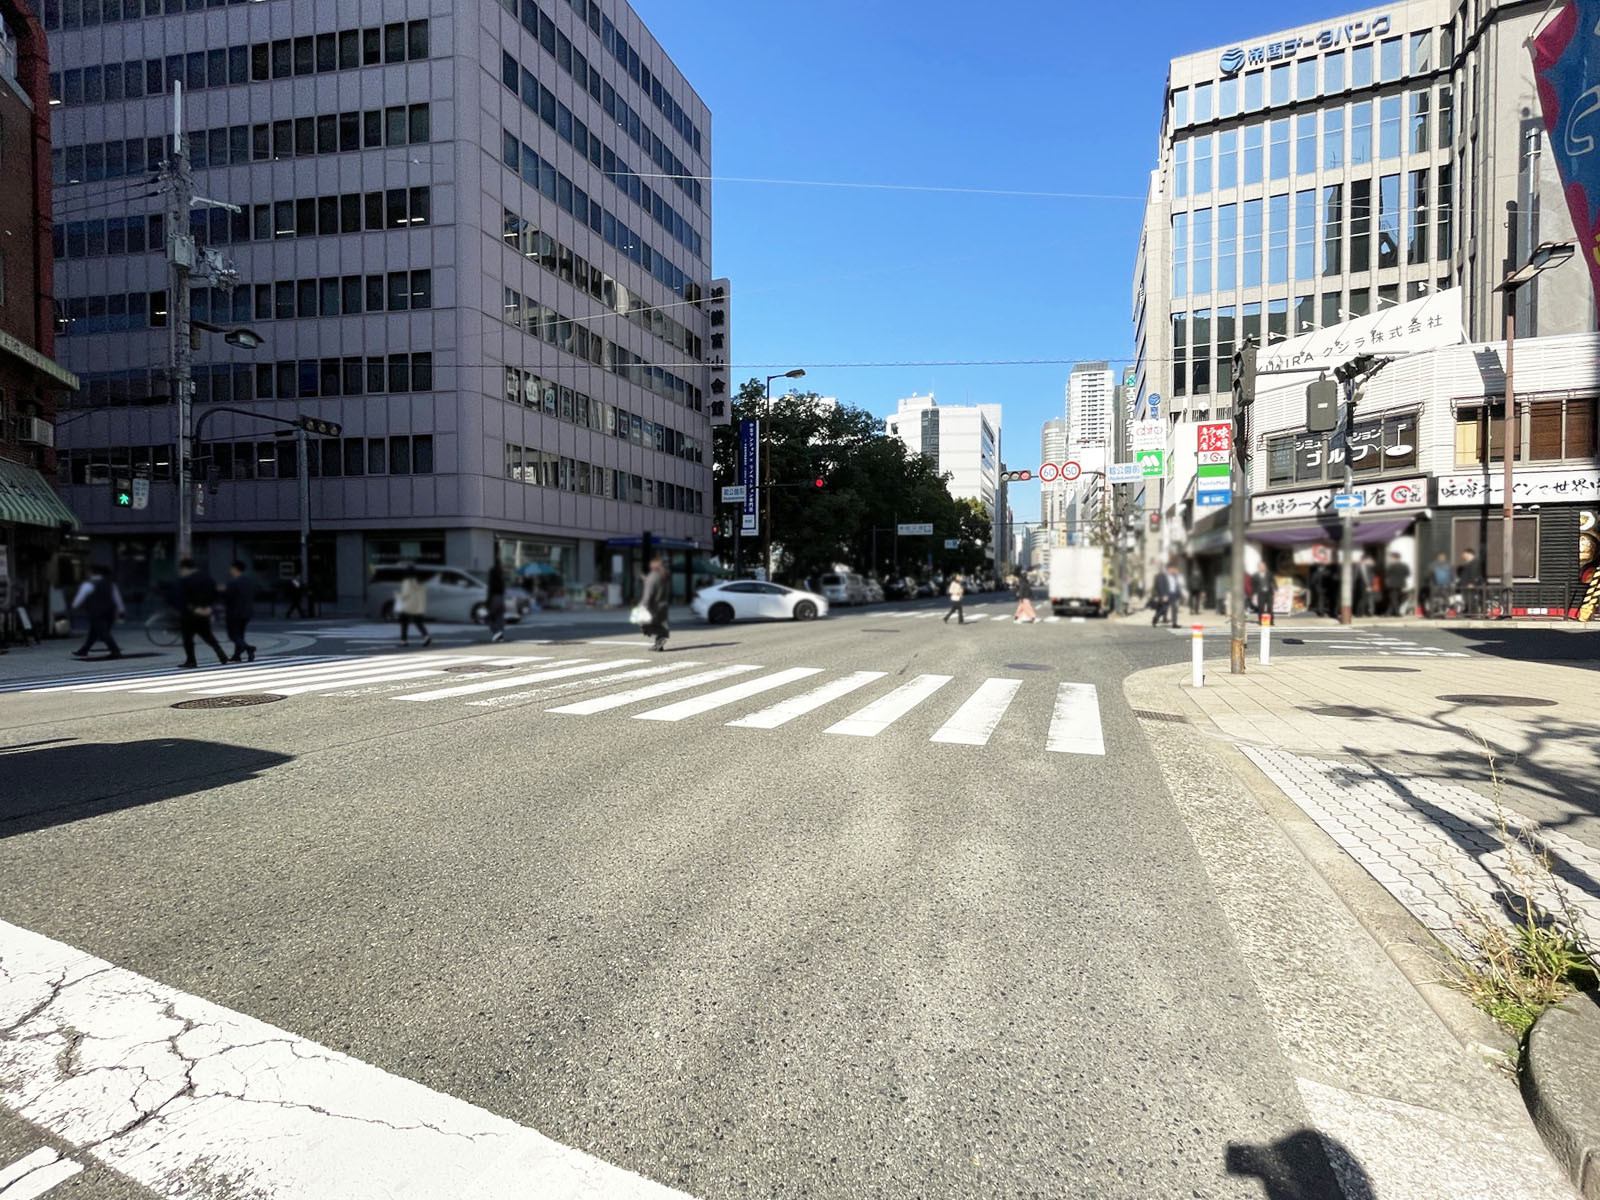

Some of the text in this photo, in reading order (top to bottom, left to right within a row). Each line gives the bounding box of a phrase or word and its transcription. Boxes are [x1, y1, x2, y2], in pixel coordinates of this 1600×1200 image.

[1248, 14, 1391, 65] 帝国データバンク
[1295, 429, 1382, 451] シミュション
[1043, 468, 1055, 477] 60
[1065, 466, 1078, 476] 50
[1256, 488, 1386, 516] 味噌ラーメン店
